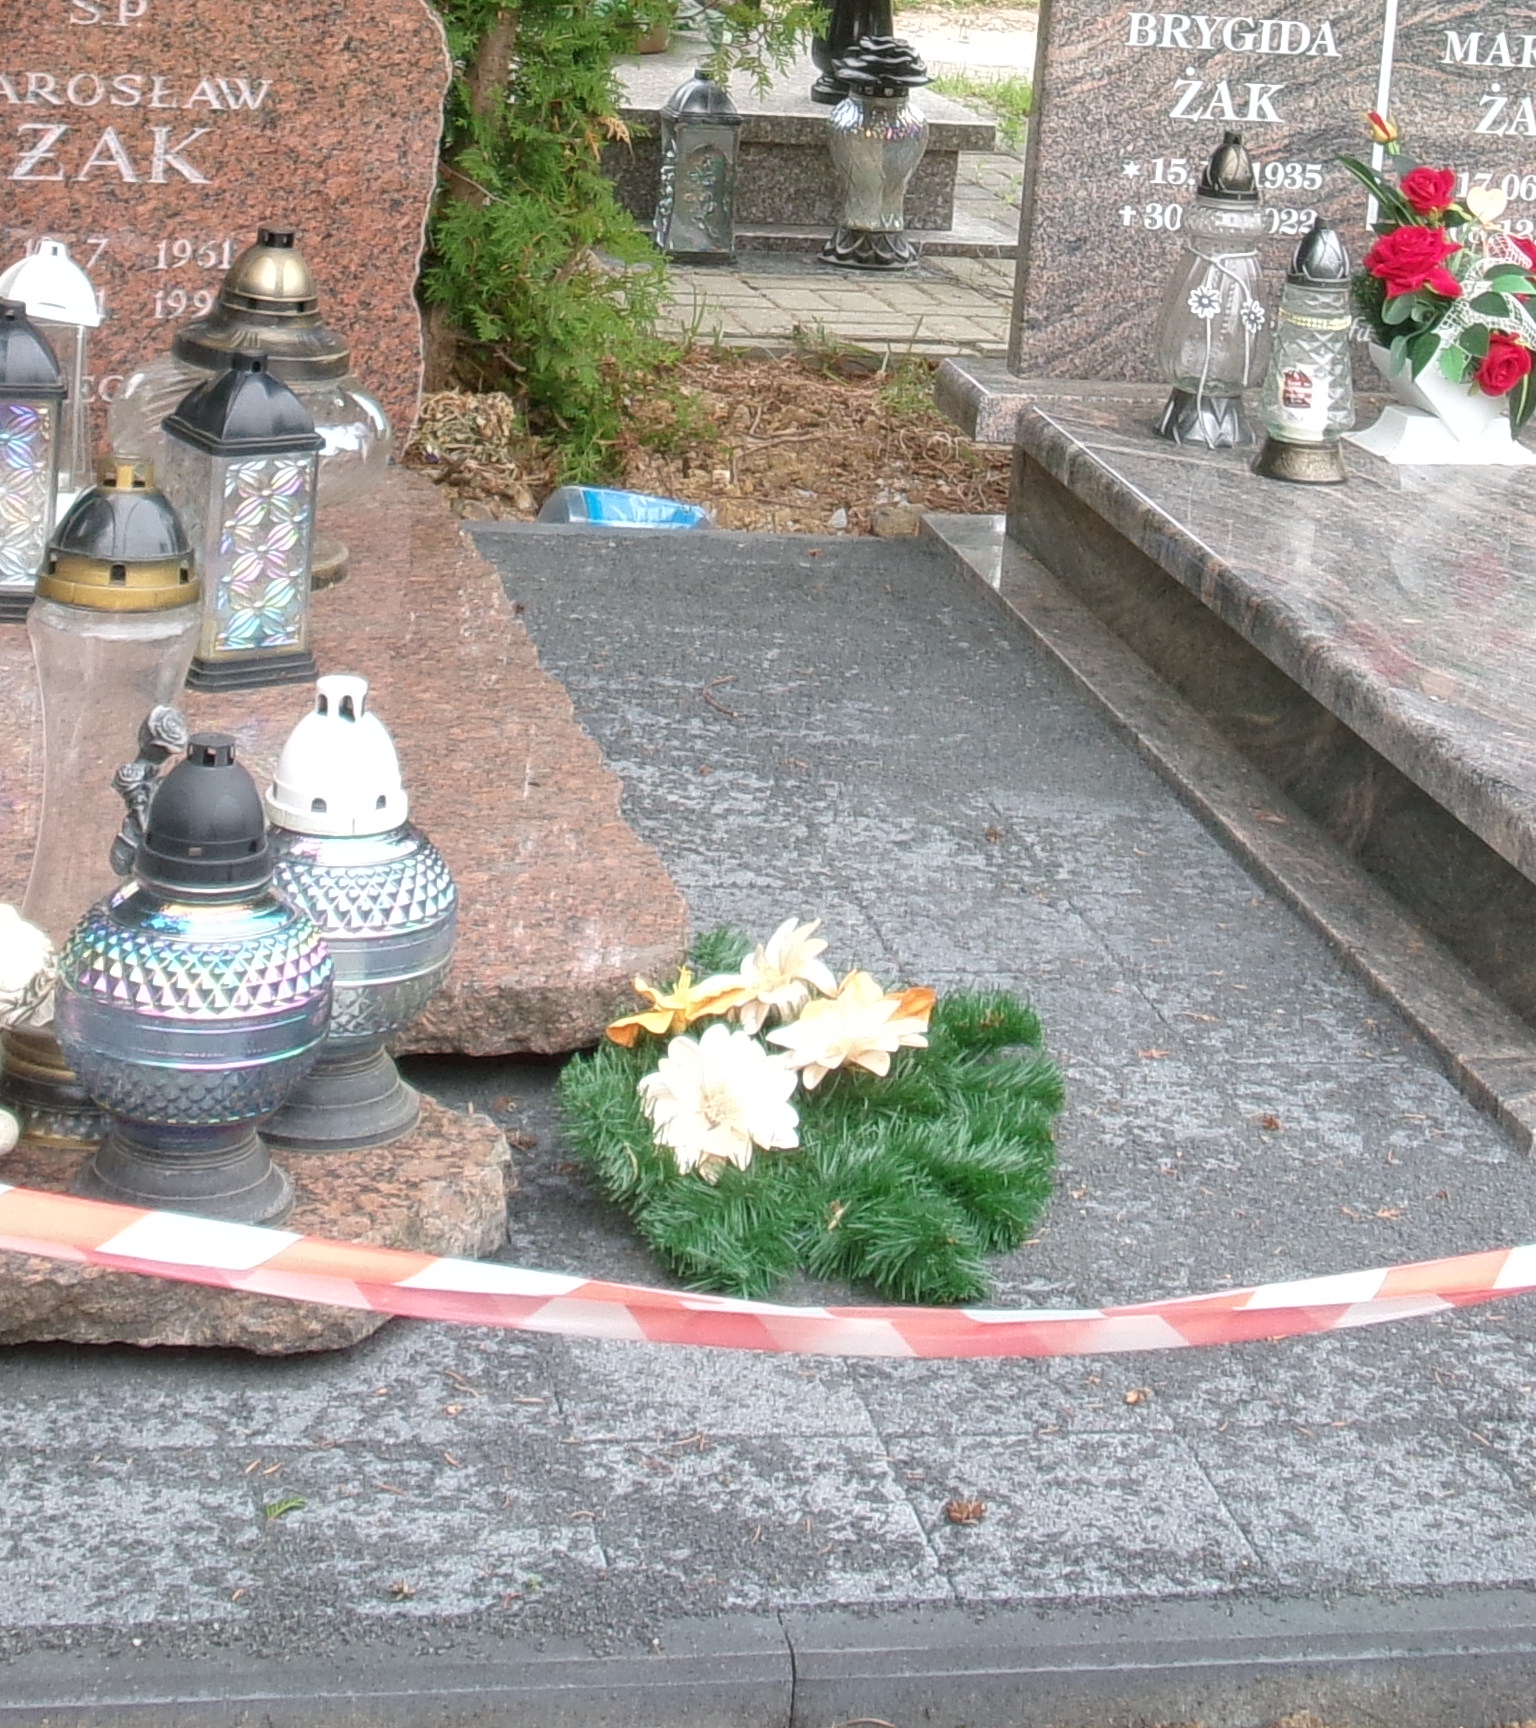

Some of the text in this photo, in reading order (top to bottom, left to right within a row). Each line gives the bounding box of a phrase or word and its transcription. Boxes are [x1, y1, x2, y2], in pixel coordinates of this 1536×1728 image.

[1124, 12, 1342, 58] BRYGIDA
[1169, 66, 1285, 122] ŻAK
[154, 288, 215, 320] 199
